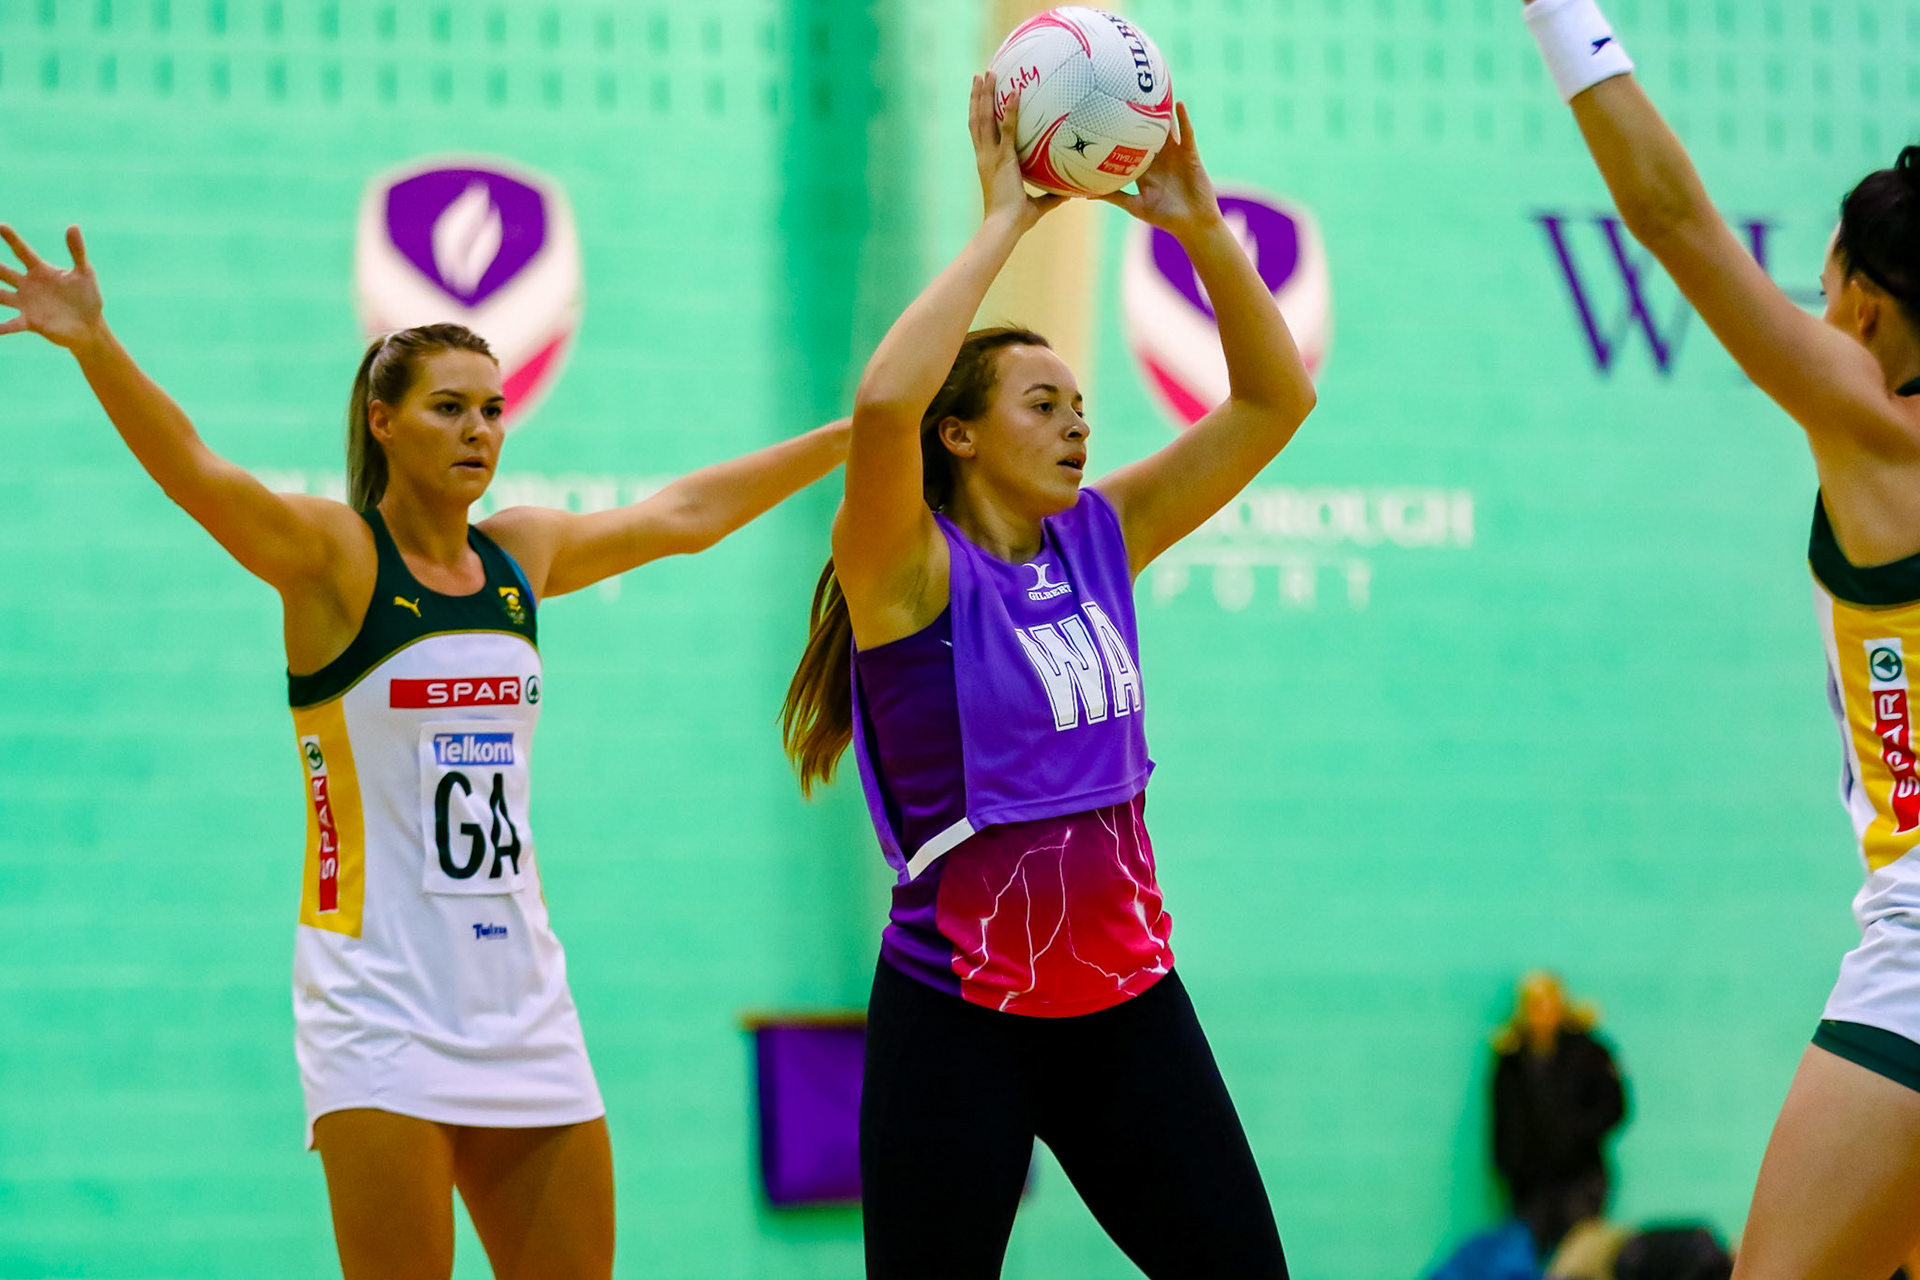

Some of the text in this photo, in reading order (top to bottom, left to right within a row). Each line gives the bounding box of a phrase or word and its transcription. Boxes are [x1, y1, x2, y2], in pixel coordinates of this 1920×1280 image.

[1028, 584, 1072, 601] GILBERT
[426, 680, 520, 704] SPAR
[1014, 601, 1142, 732] WA
[435, 736, 514, 763] Telkom
[1879, 693, 1920, 798] SPAR
[313, 778, 336, 880] SPAR
[434, 771, 522, 880] GA
